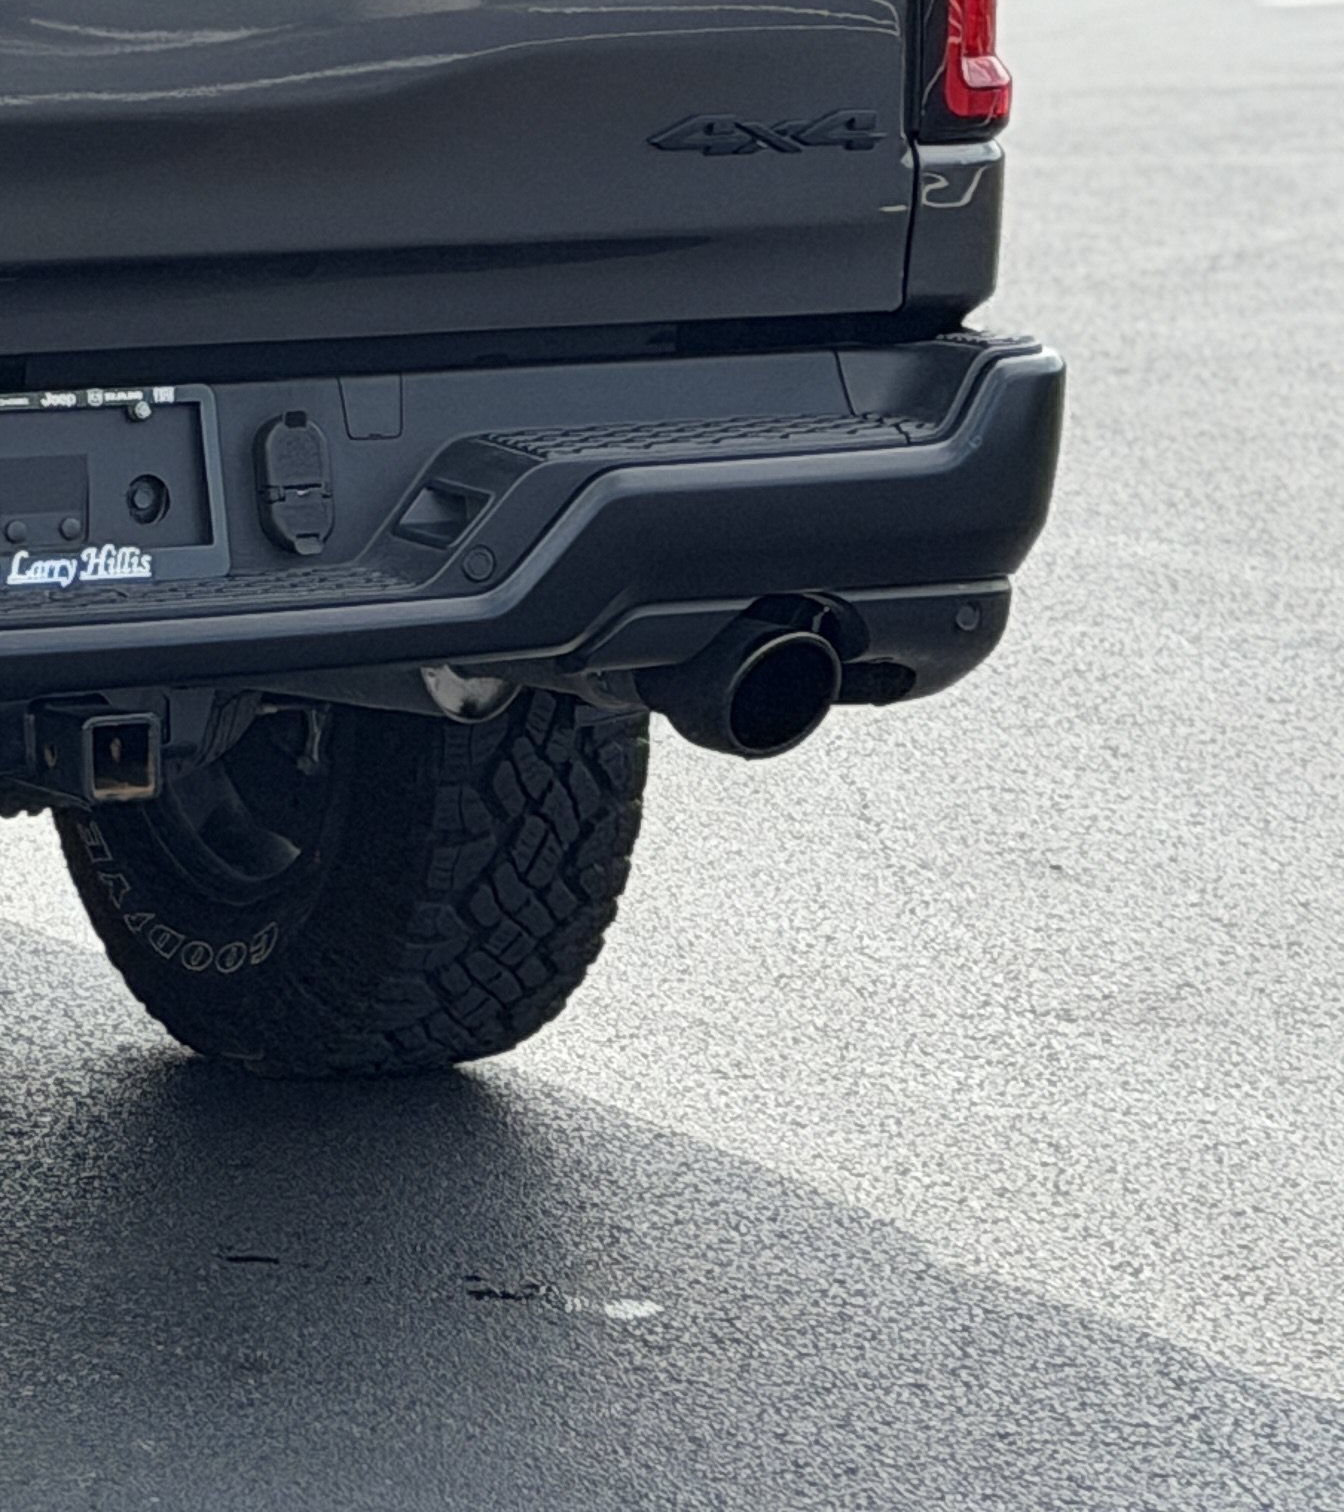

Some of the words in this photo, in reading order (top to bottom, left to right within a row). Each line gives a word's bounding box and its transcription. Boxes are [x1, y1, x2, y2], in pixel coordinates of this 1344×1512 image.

[40, 392, 76, 408] Jeep
[7, 550, 78, 588] Larry
[79, 543, 153, 580] Hillis
